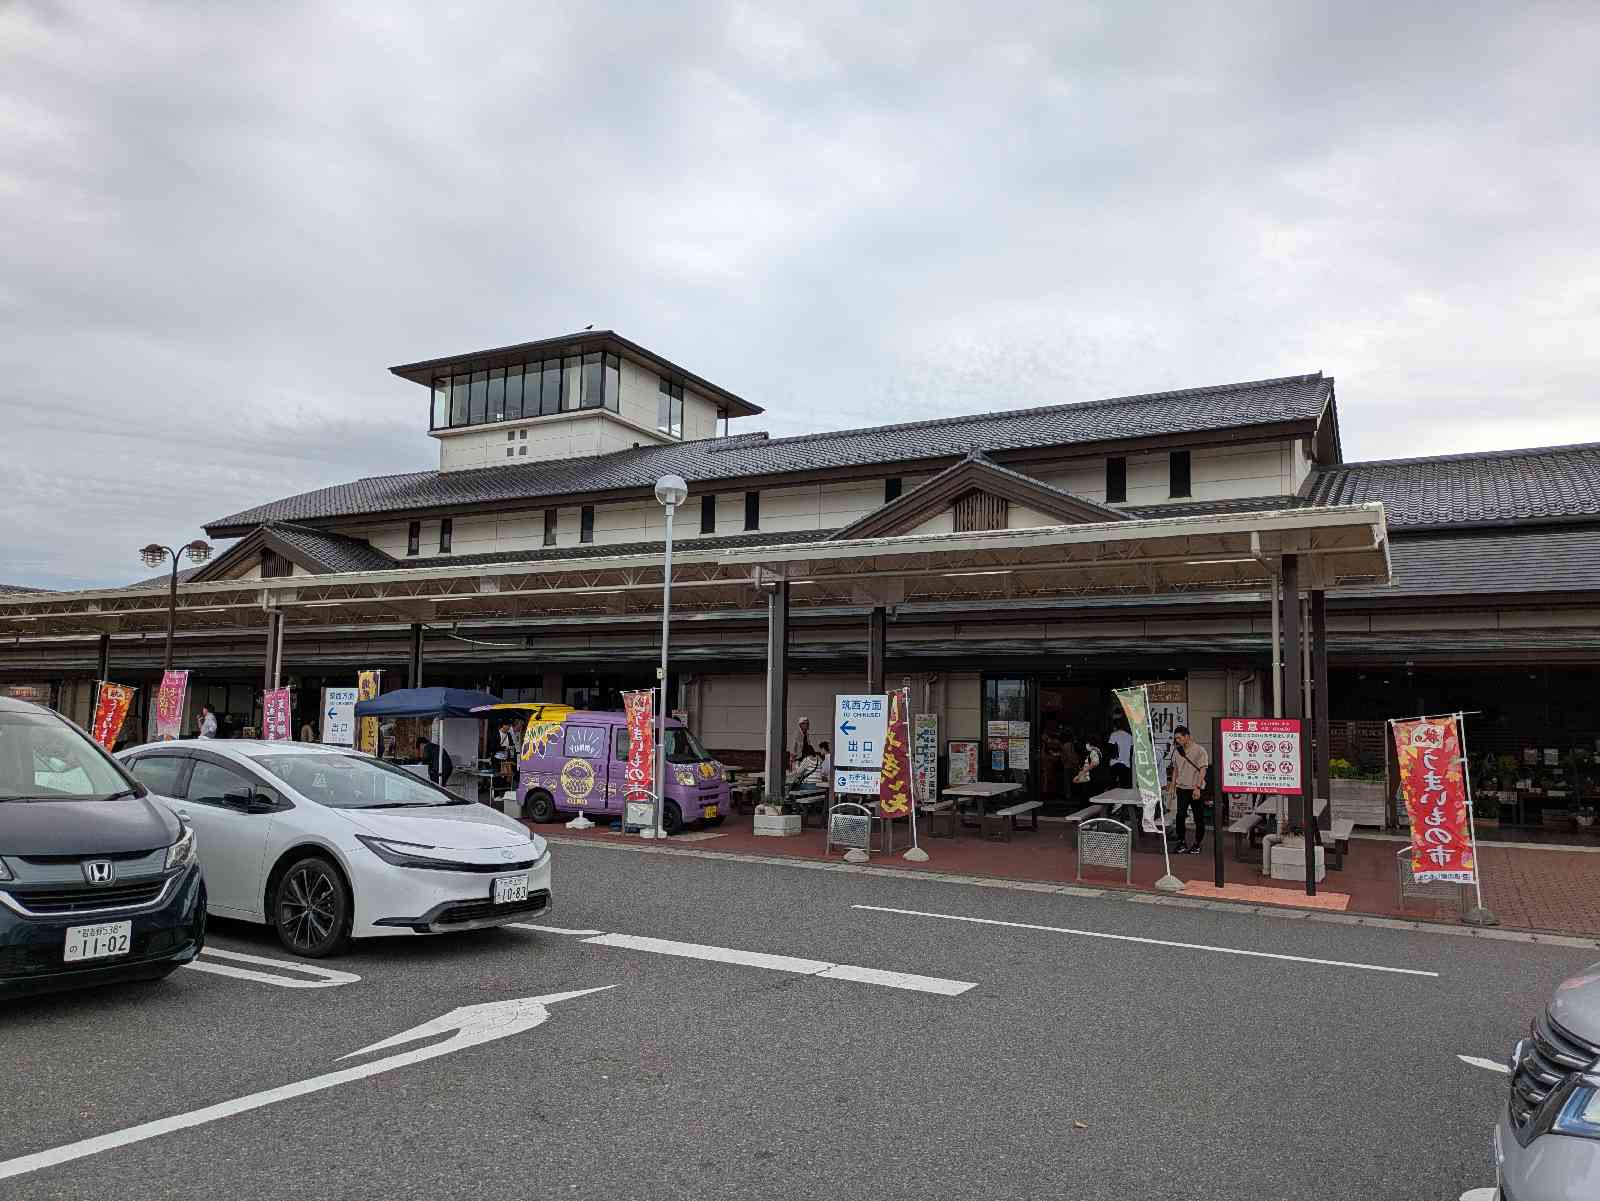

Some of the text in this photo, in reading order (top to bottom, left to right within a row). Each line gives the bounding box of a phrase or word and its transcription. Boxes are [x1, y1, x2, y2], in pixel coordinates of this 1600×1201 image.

[841, 699, 882, 711] 筑西方面
[1232, 720, 1258, 732] 注意
[848, 739, 873, 752] 出口
[82, 934, 128, 957] 11-02
